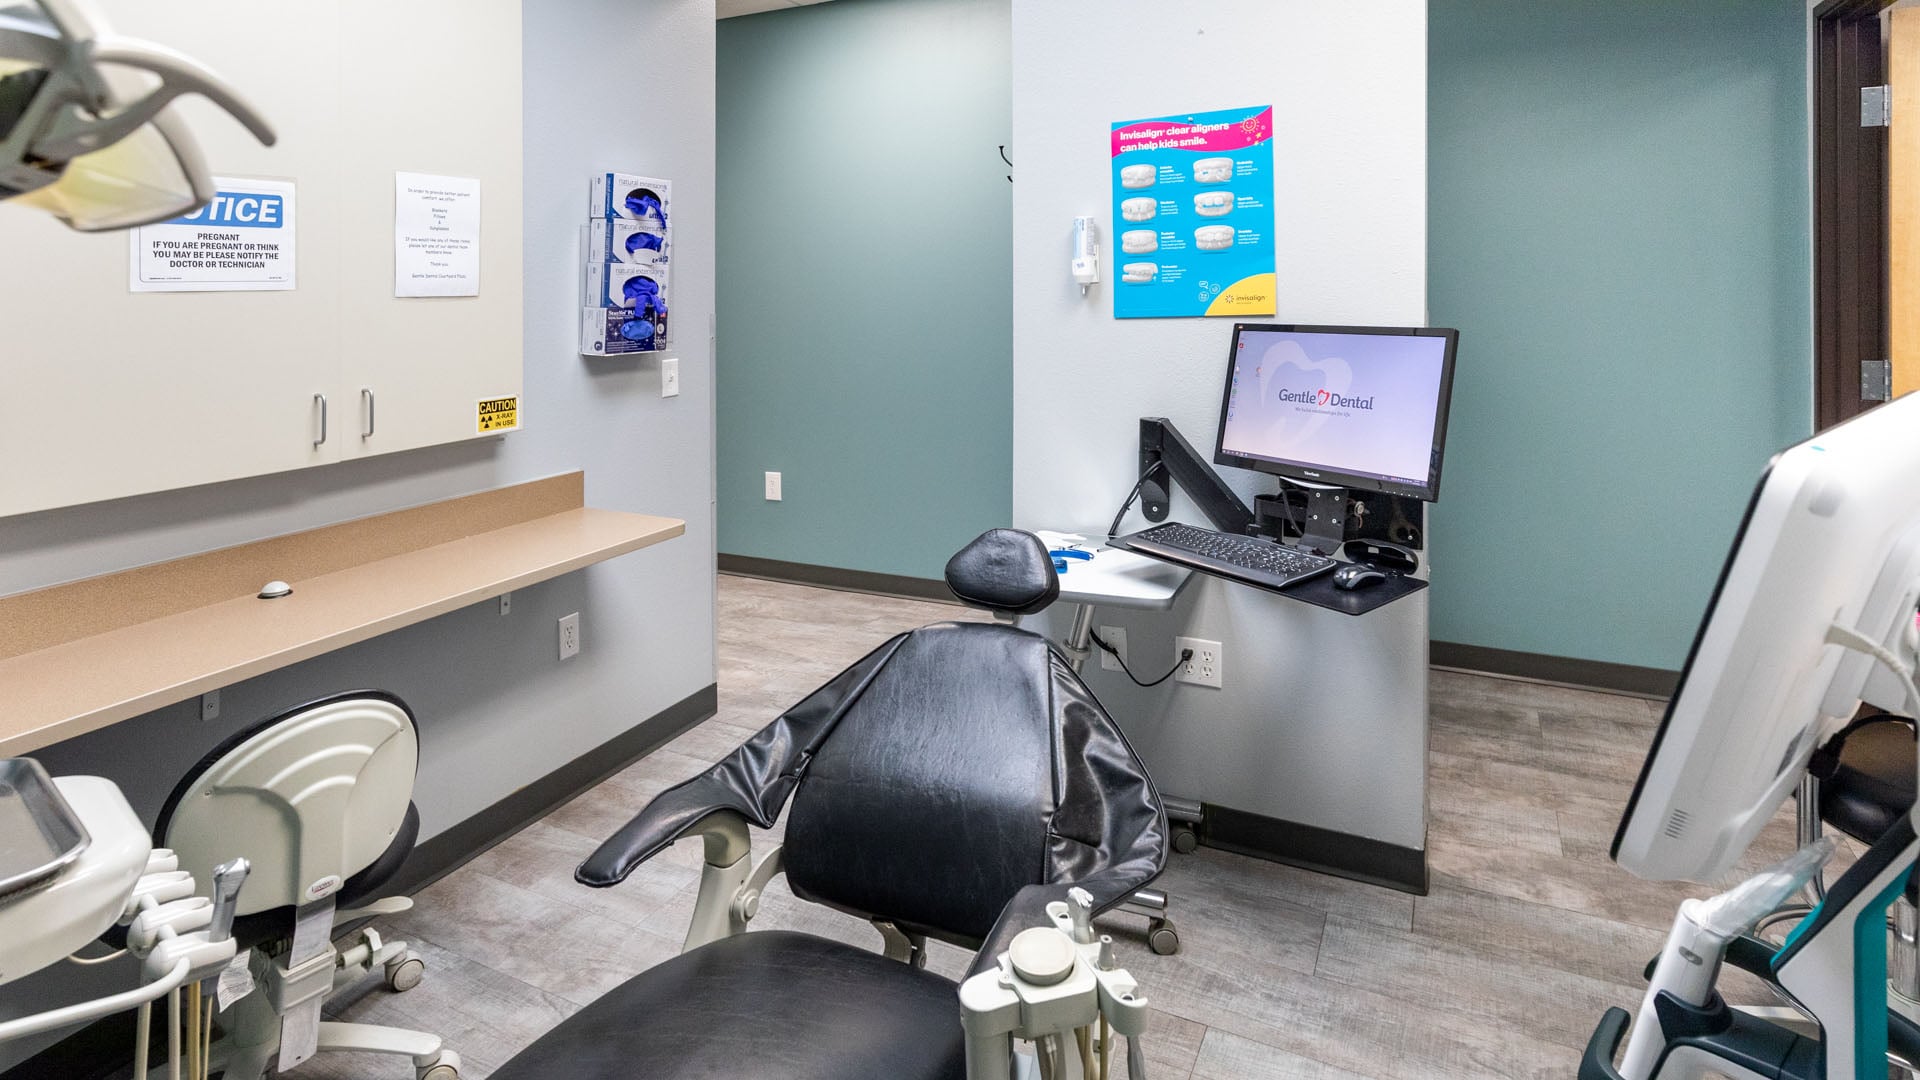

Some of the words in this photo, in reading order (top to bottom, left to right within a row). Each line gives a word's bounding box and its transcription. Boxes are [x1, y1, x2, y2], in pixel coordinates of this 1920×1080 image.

[1166, 126, 1190, 136] clear
[1190, 123, 1230, 134] aligners
[1120, 144, 1138, 152] can
[1138, 140, 1158, 152] help
[1159, 138, 1178, 148] kids
[1180, 136, 1208, 147] smile.
[184, 196, 280, 223] TICE
[197, 233, 240, 241] PREGNANT
[153, 241, 161, 249] IF
[1279, 388, 1316, 404] Gentle
[1331, 393, 1374, 410] Dental
[480, 400, 516, 413] CAUTION
